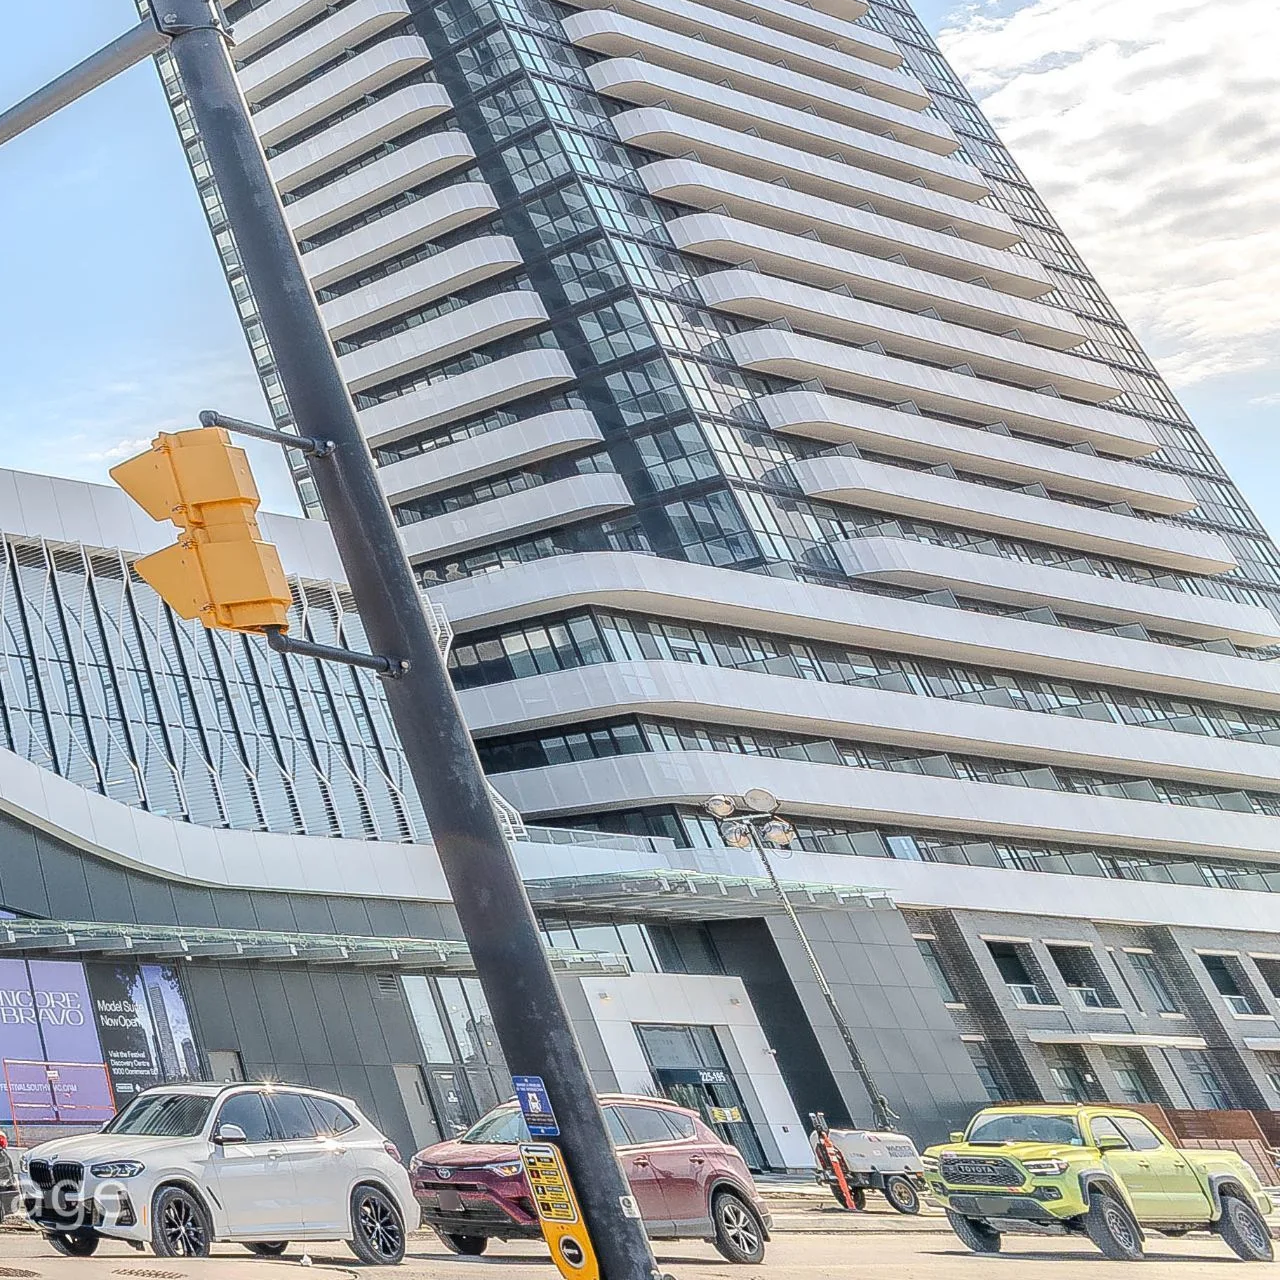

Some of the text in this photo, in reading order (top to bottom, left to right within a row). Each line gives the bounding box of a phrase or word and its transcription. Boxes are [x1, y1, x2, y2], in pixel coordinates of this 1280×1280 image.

[97, 999, 124, 1013] Model
[0, 1006, 85, 1026] BRAVO
[100, 1014, 119, 1027] Now
[960, 1165, 994, 1174] TOYOTA
